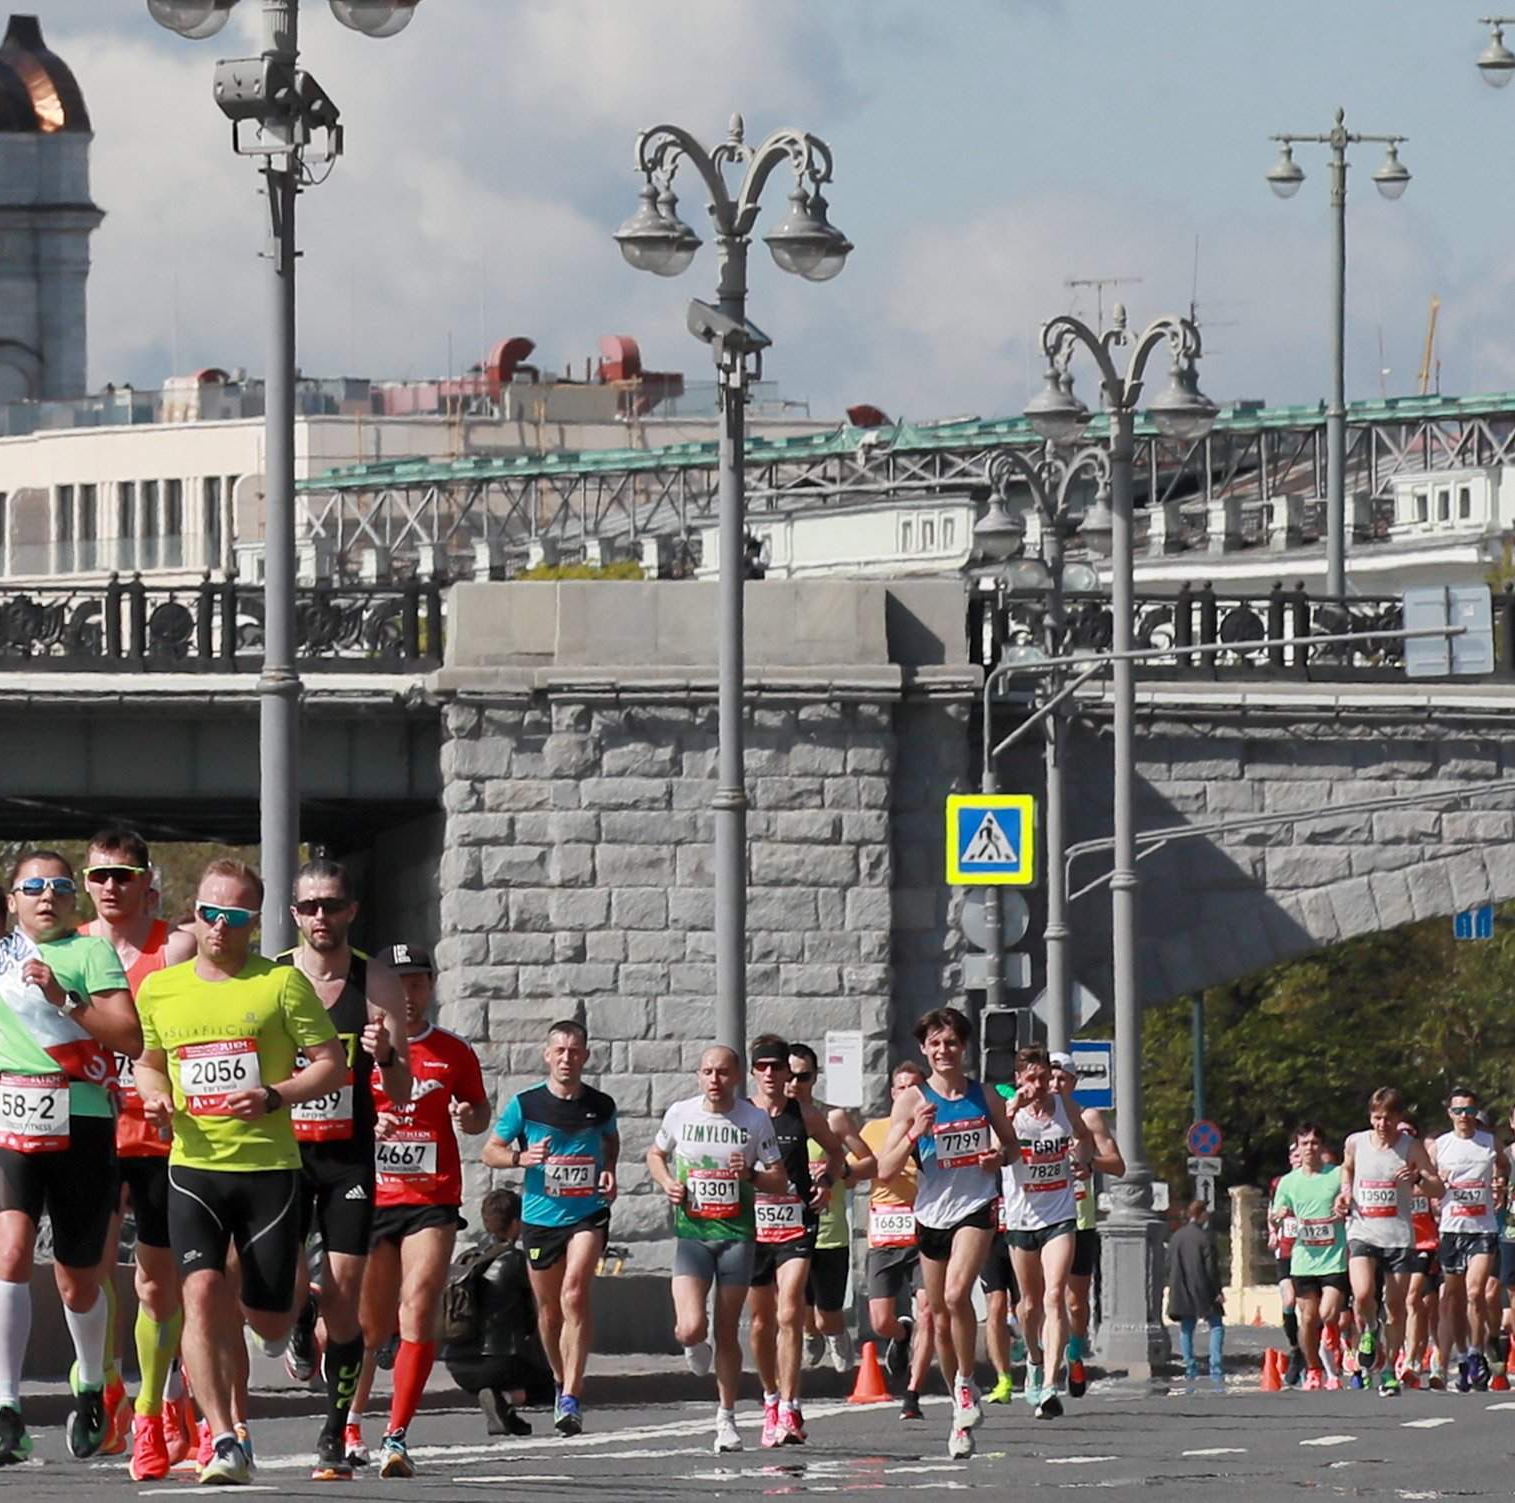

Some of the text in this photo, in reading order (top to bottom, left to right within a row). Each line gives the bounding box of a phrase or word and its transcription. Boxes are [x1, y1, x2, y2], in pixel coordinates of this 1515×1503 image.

[191, 1058, 246, 1085] 2056
[1, 1093, 55, 1120] 58-2
[682, 1123, 749, 1145] IZMYLONG
[943, 1131, 980, 1151] 7799
[377, 1146, 426, 1165] 4667
[552, 1167, 588, 1181] 4173
[1029, 1164, 1061, 1179] 7828
[692, 1182, 735, 1197] 13301
[757, 1206, 794, 1222] 5542
[874, 1216, 912, 1230] 16635
